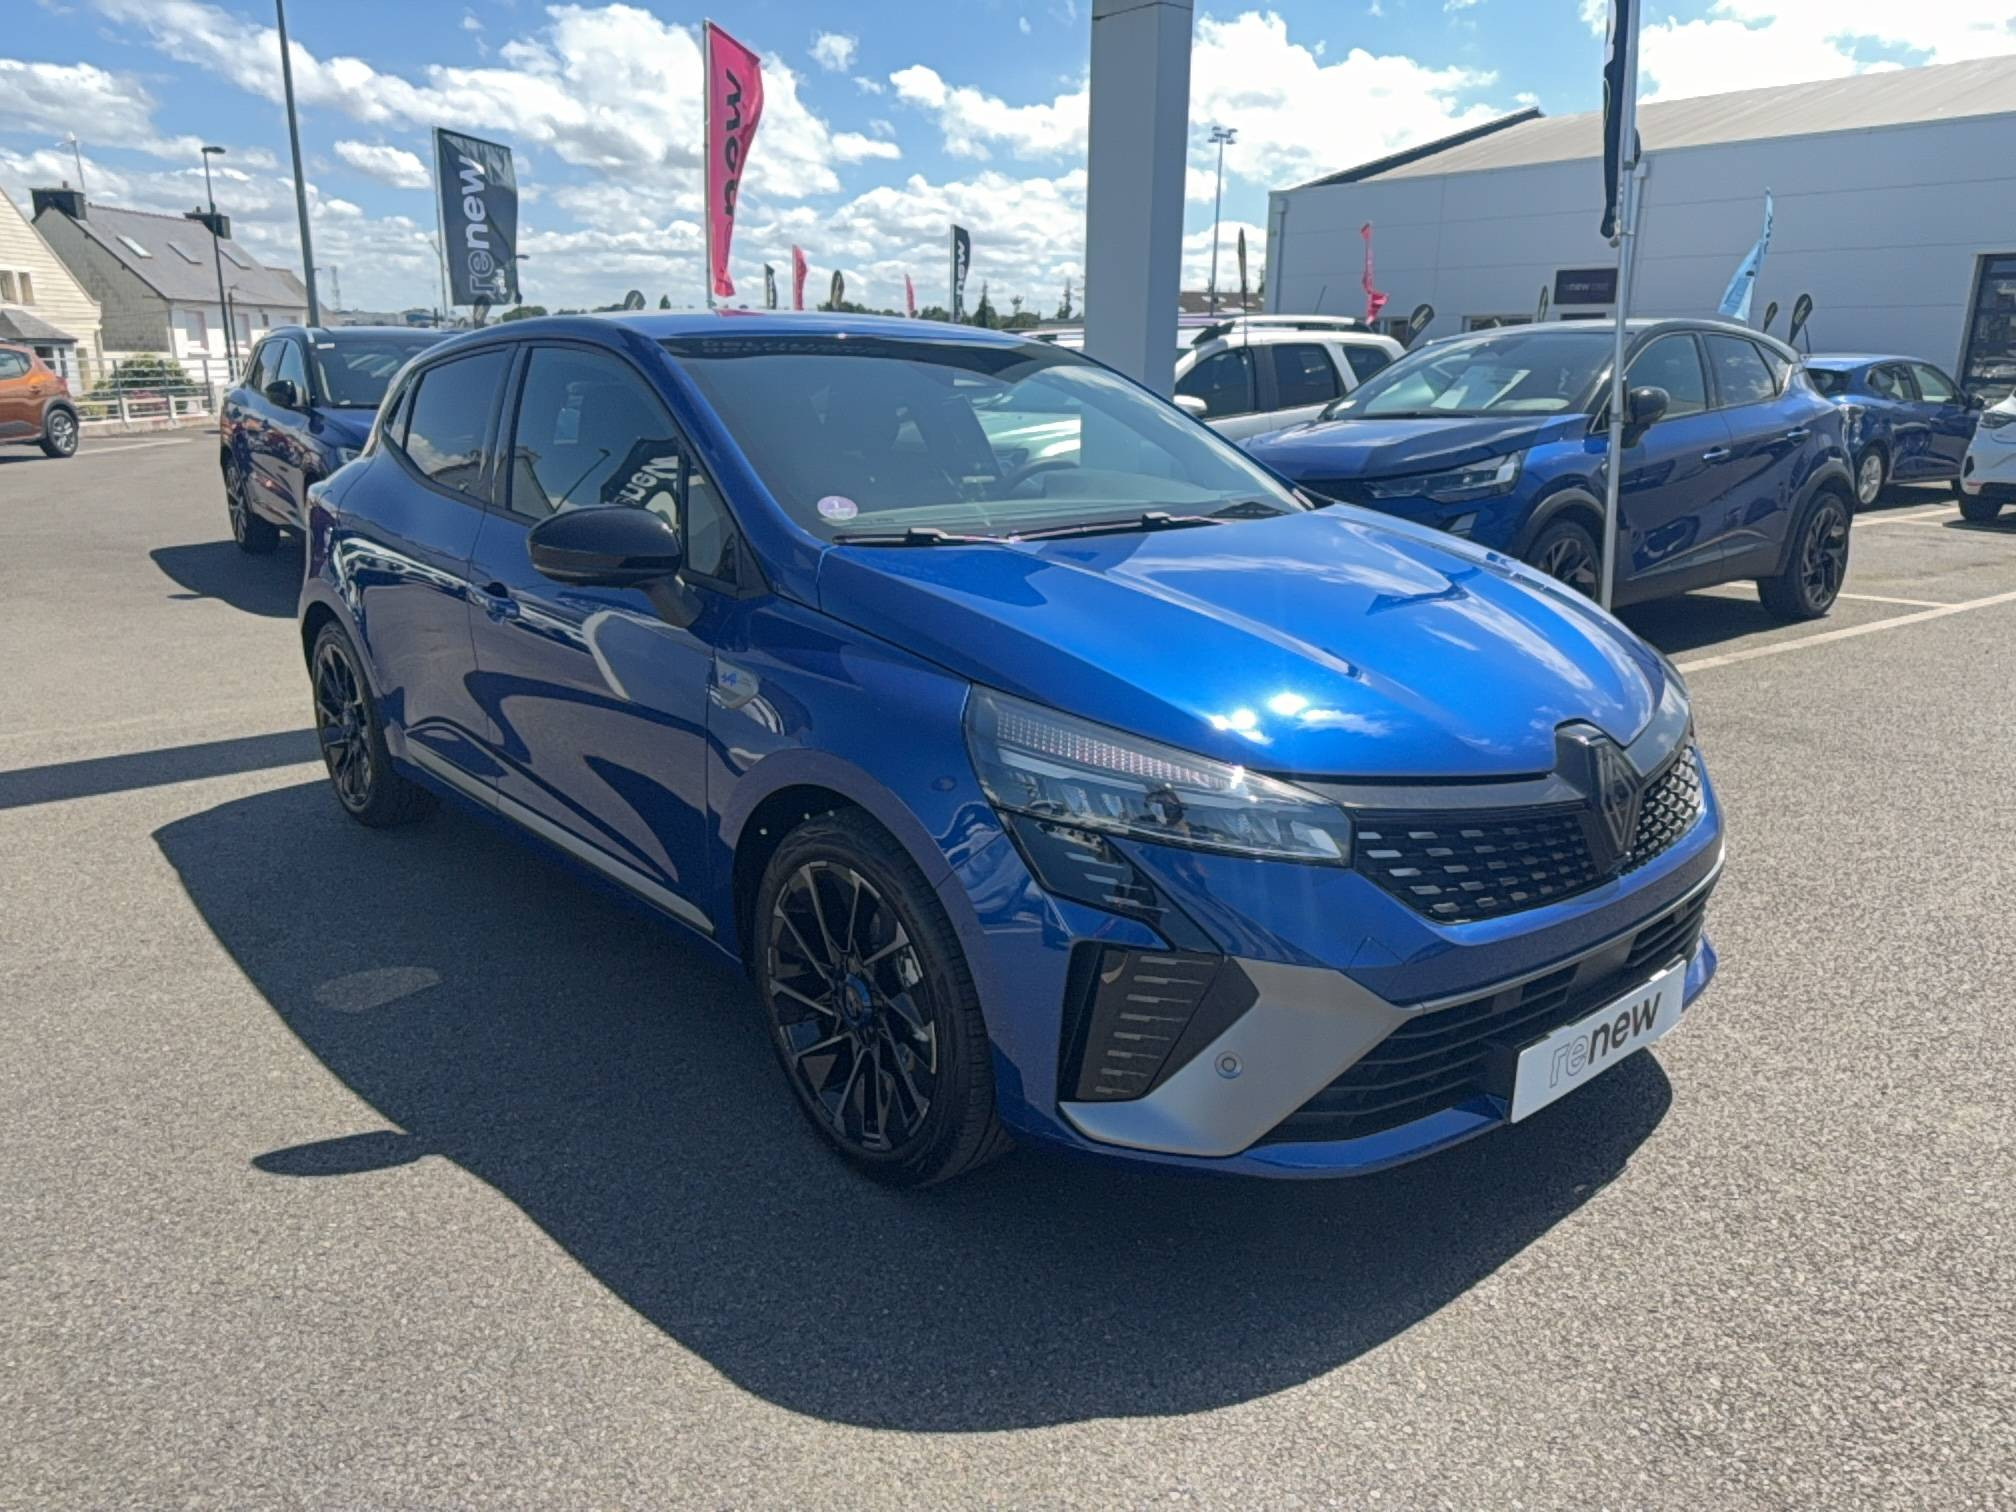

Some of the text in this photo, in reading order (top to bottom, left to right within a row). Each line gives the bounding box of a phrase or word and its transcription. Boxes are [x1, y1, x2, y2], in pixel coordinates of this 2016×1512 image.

[723, 67, 742, 228] new
[458, 155, 497, 296] renew
[1550, 991, 1662, 1089] renew
